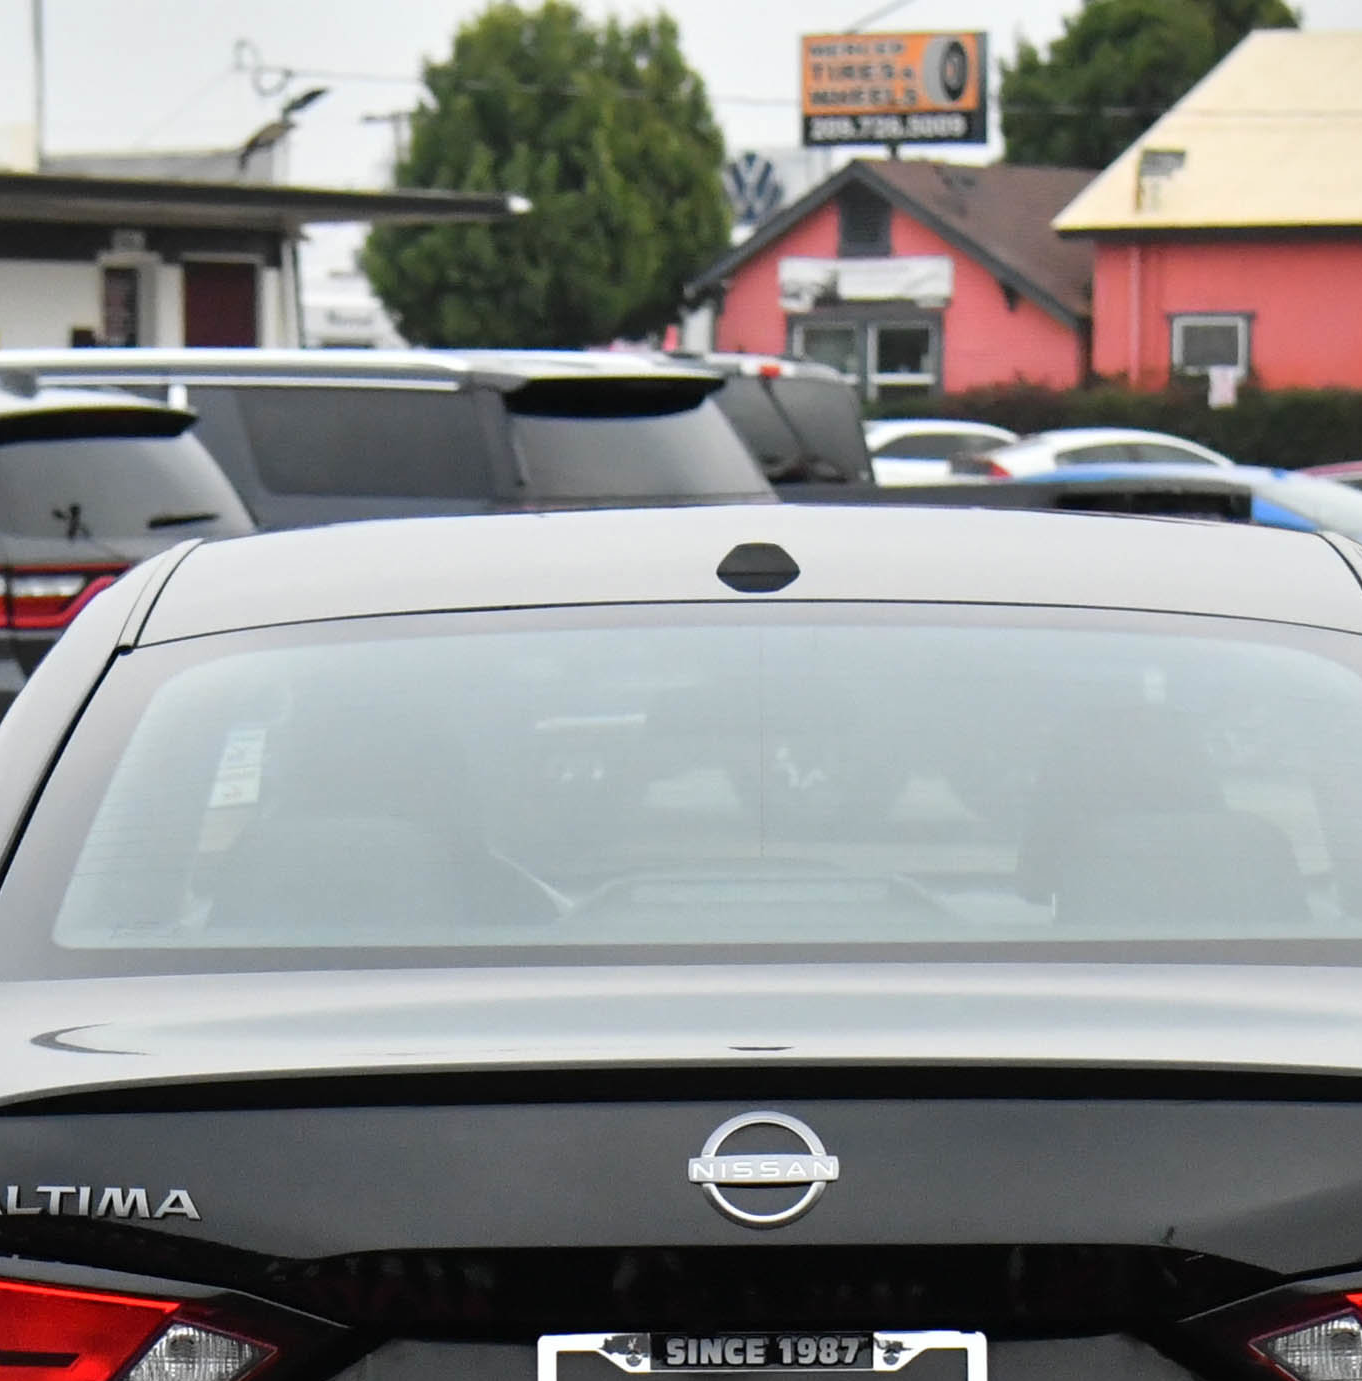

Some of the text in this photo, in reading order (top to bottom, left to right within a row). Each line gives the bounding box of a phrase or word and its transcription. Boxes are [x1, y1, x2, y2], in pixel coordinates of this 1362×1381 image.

[692, 1160, 834, 1179] NISSAN
[665, 1336, 861, 1366] SINCE 1987
